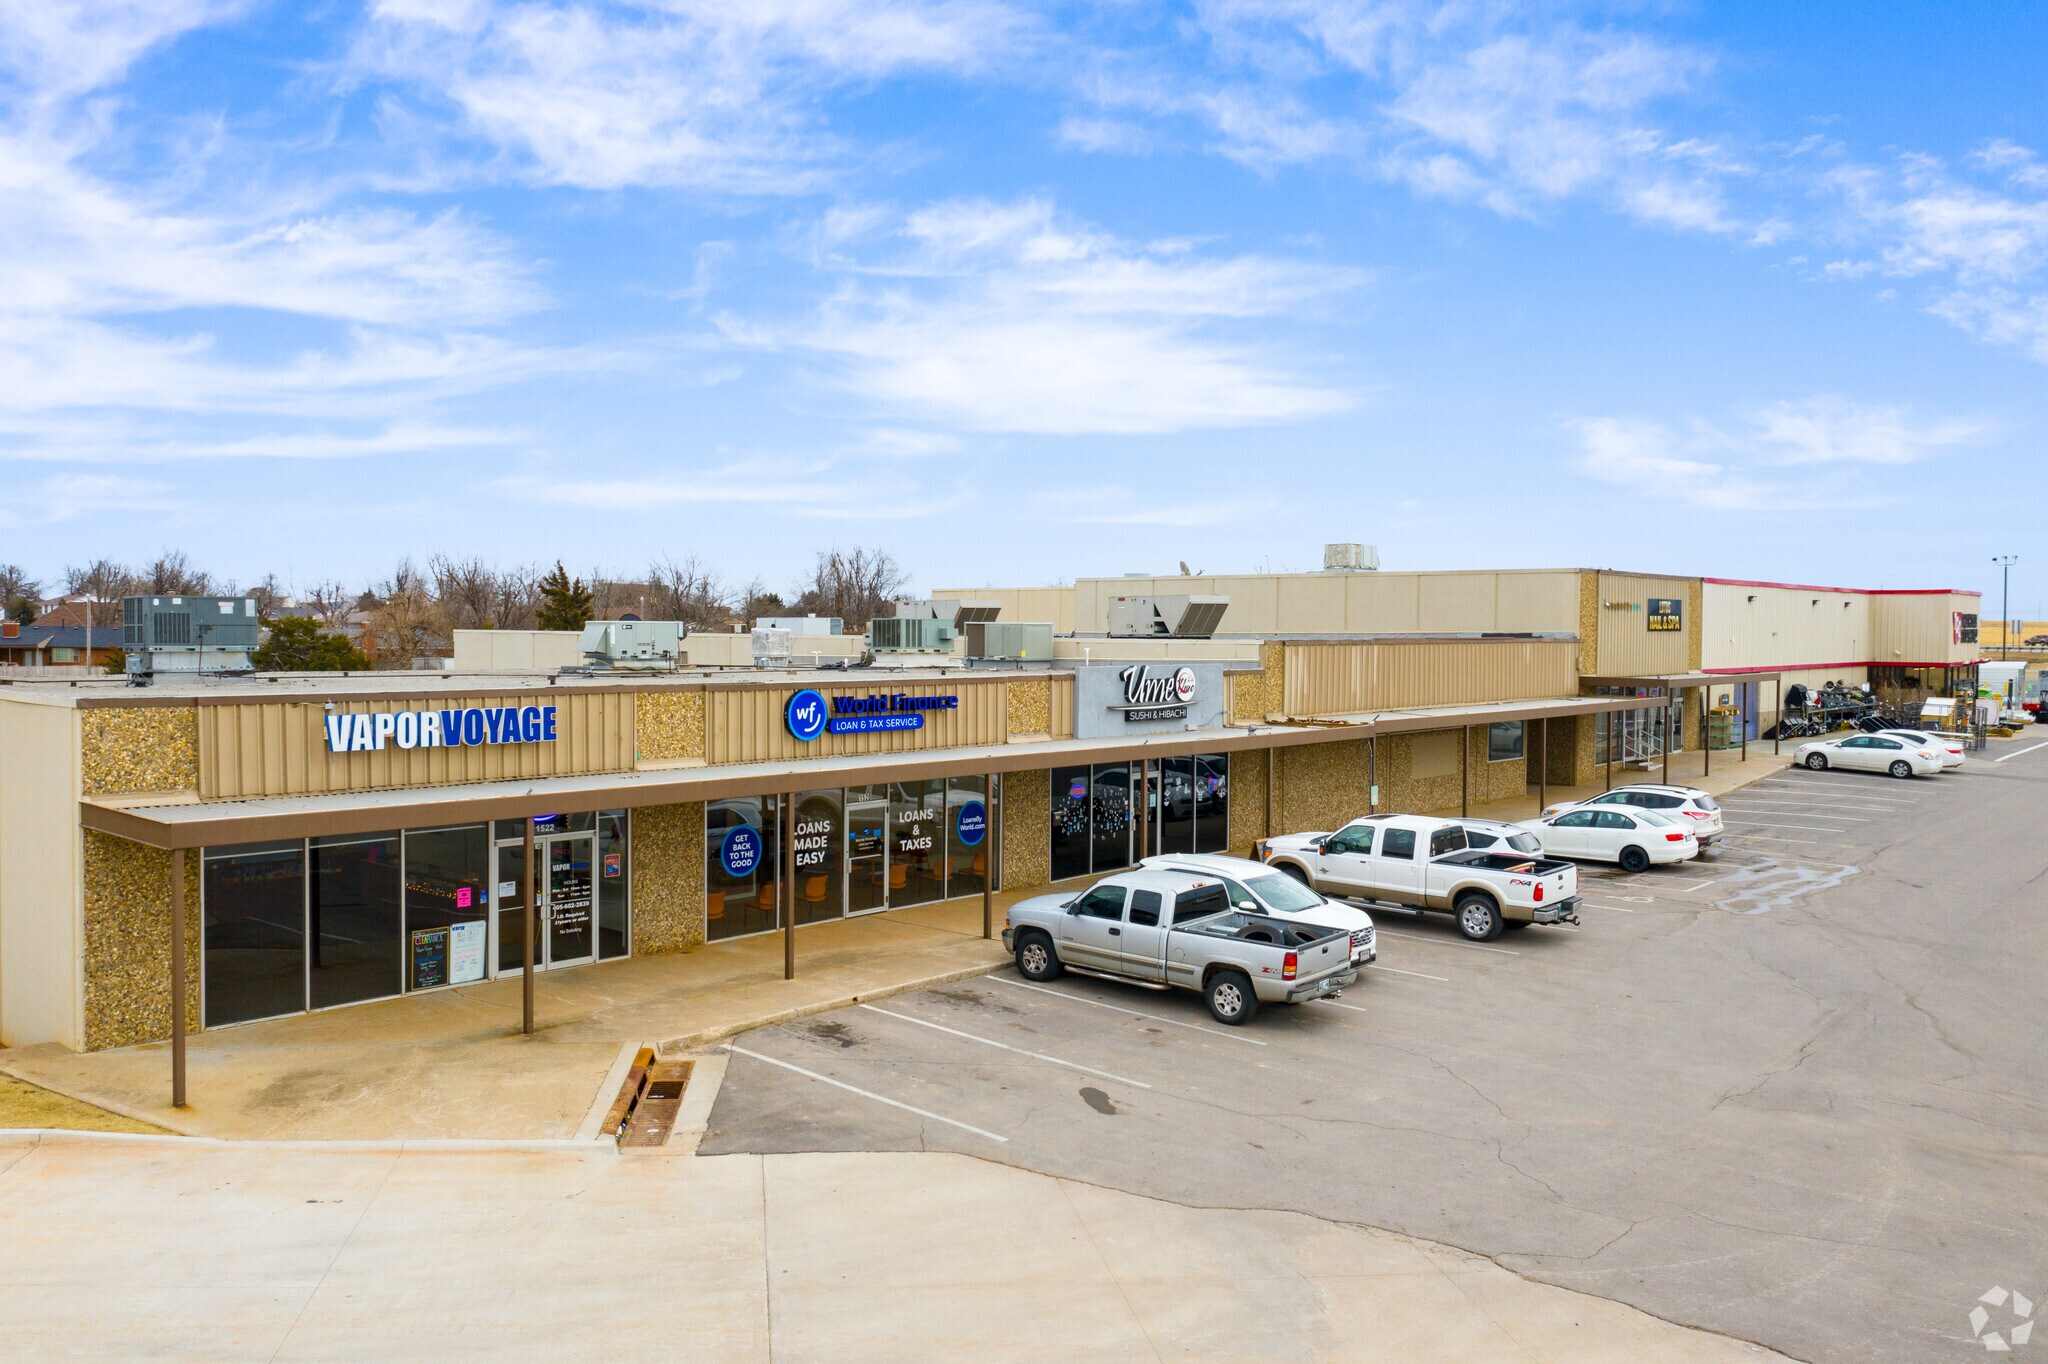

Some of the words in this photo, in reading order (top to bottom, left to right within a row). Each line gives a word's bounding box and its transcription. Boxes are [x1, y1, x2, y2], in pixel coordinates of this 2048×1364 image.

[1649, 615, 1662, 630] NAIL
[1662, 616, 1668, 630] &
[1668, 615, 1680, 630] SPA
[1120, 665, 1175, 704] Ume
[834, 694, 888, 714] World
[893, 693, 959, 711] Finance
[1129, 711, 1152, 720] SUSHI
[1153, 711, 1158, 719] &
[1159, 709, 1187, 719] HIBACHI
[836, 720, 858, 731] LOAN
[860, 719, 866, 729] &
[869, 719, 884, 729] TAX
[885, 717, 918, 728] SERVICE
[899, 808, 934, 823] LOANS
[535, 823, 555, 832] 1522
[912, 824, 920, 836] &
[735, 834, 748, 843] GET
[794, 836, 828, 852] MADE
[900, 836, 932, 852] TAXES
[732, 842, 751, 852] BACK
[729, 851, 740, 860] TO
[740, 850, 754, 859] THE
[796, 851, 825, 866] EASY
[731, 859, 752, 868] GOOD
